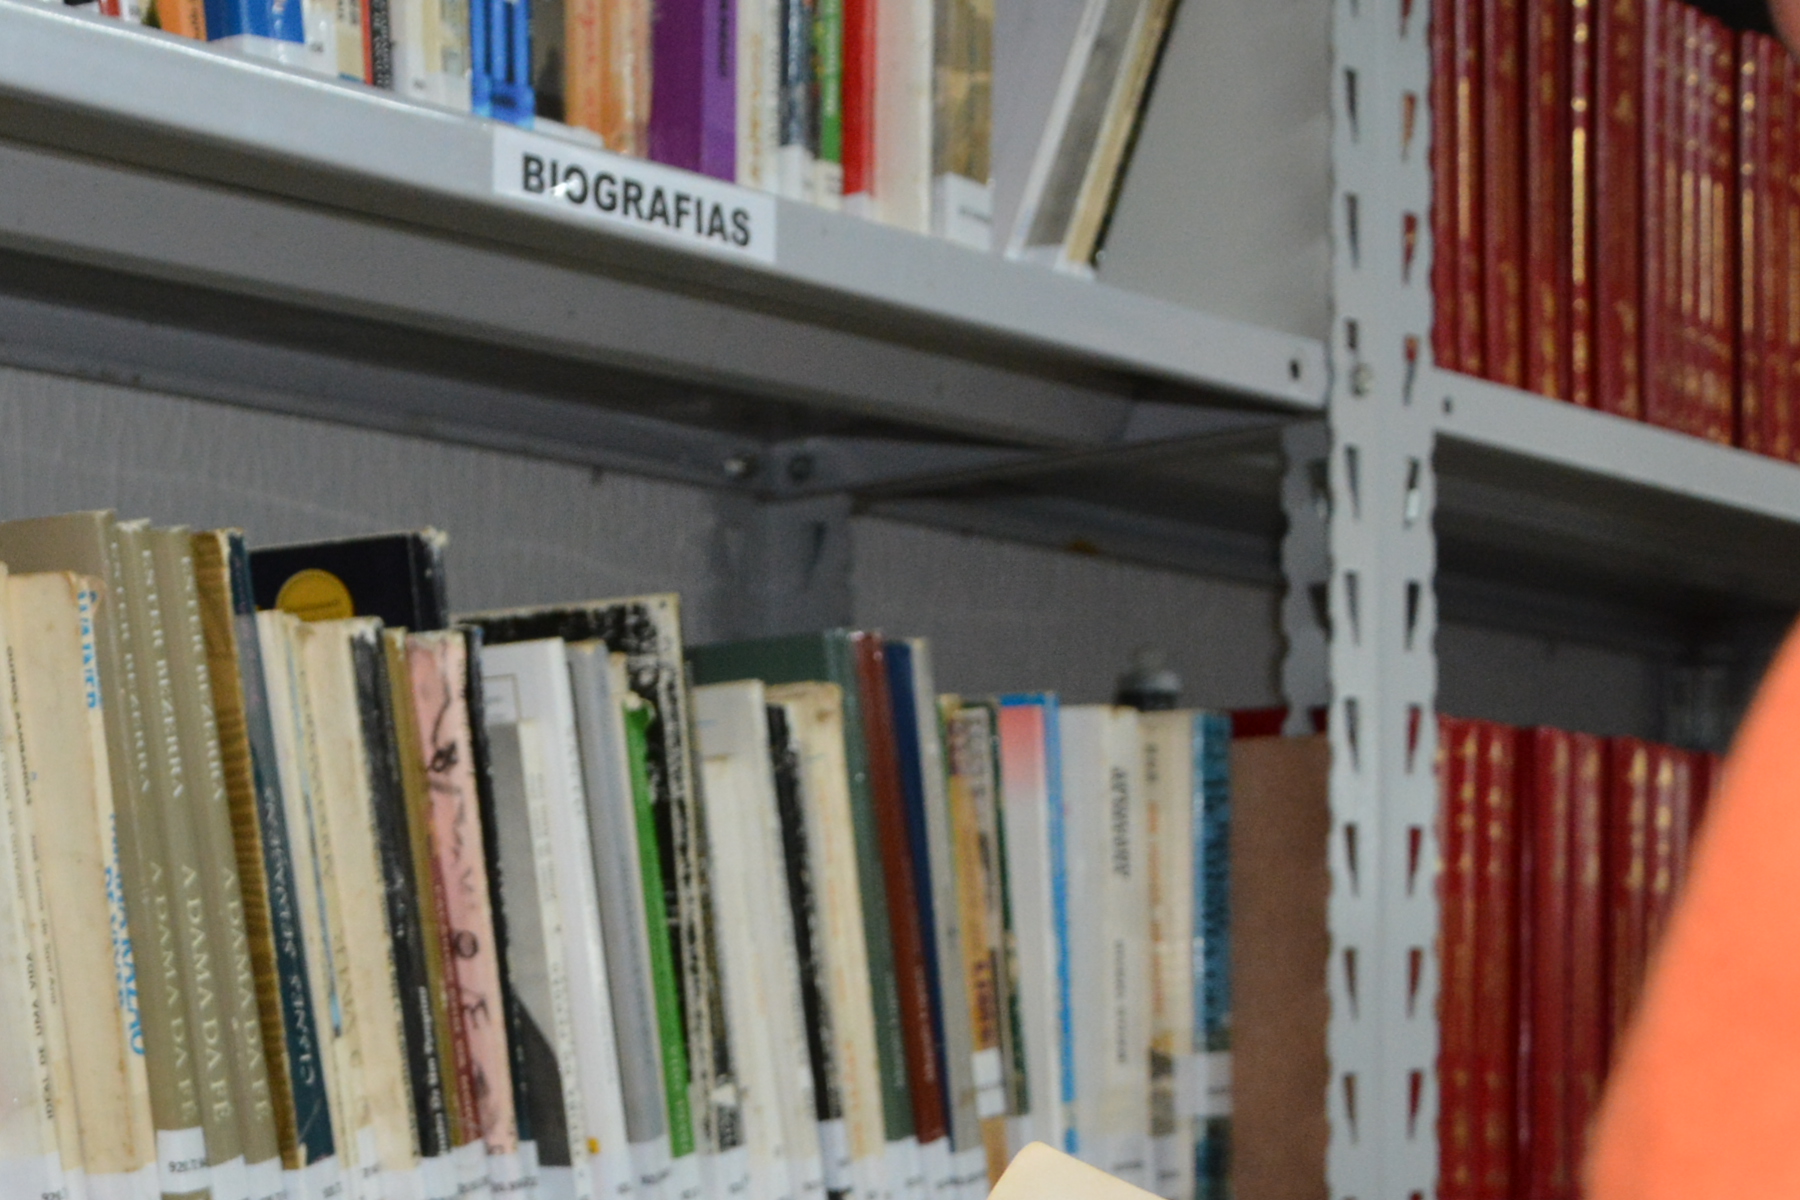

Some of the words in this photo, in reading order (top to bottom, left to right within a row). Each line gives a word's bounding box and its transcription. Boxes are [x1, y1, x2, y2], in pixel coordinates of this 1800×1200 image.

[521, 152, 751, 248] BIOGRAFIAS
[142, 549, 164, 648] ESTER
[155, 658, 184, 798] BEZERRA
[150, 862, 163, 884] A
[181, 863, 197, 890] A
[220, 866, 236, 891] A
[154, 895, 180, 1008] DAMA
[185, 896, 214, 1010] DAMA
[226, 898, 252, 1010] DAMA
[170, 1017, 188, 1070] DA
[202, 1018, 222, 1071] DA
[244, 1017, 262, 1070] DA
